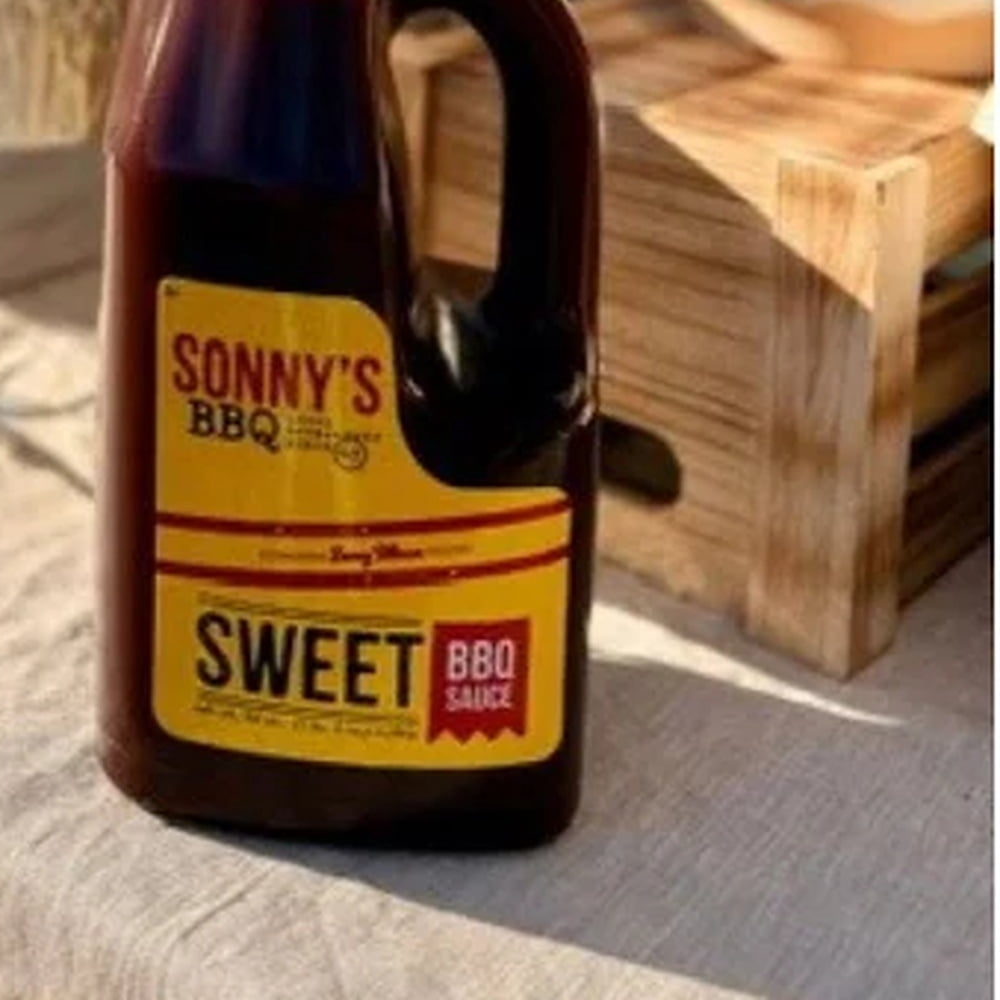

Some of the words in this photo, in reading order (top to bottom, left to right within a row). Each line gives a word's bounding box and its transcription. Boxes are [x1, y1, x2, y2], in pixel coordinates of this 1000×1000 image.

[172, 332, 383, 416] SONNY'S
[187, 399, 281, 453] BBQ
[196, 609, 424, 709] SWEET
[445, 638, 516, 682] BBQ
[445, 683, 513, 713] SAUCE
